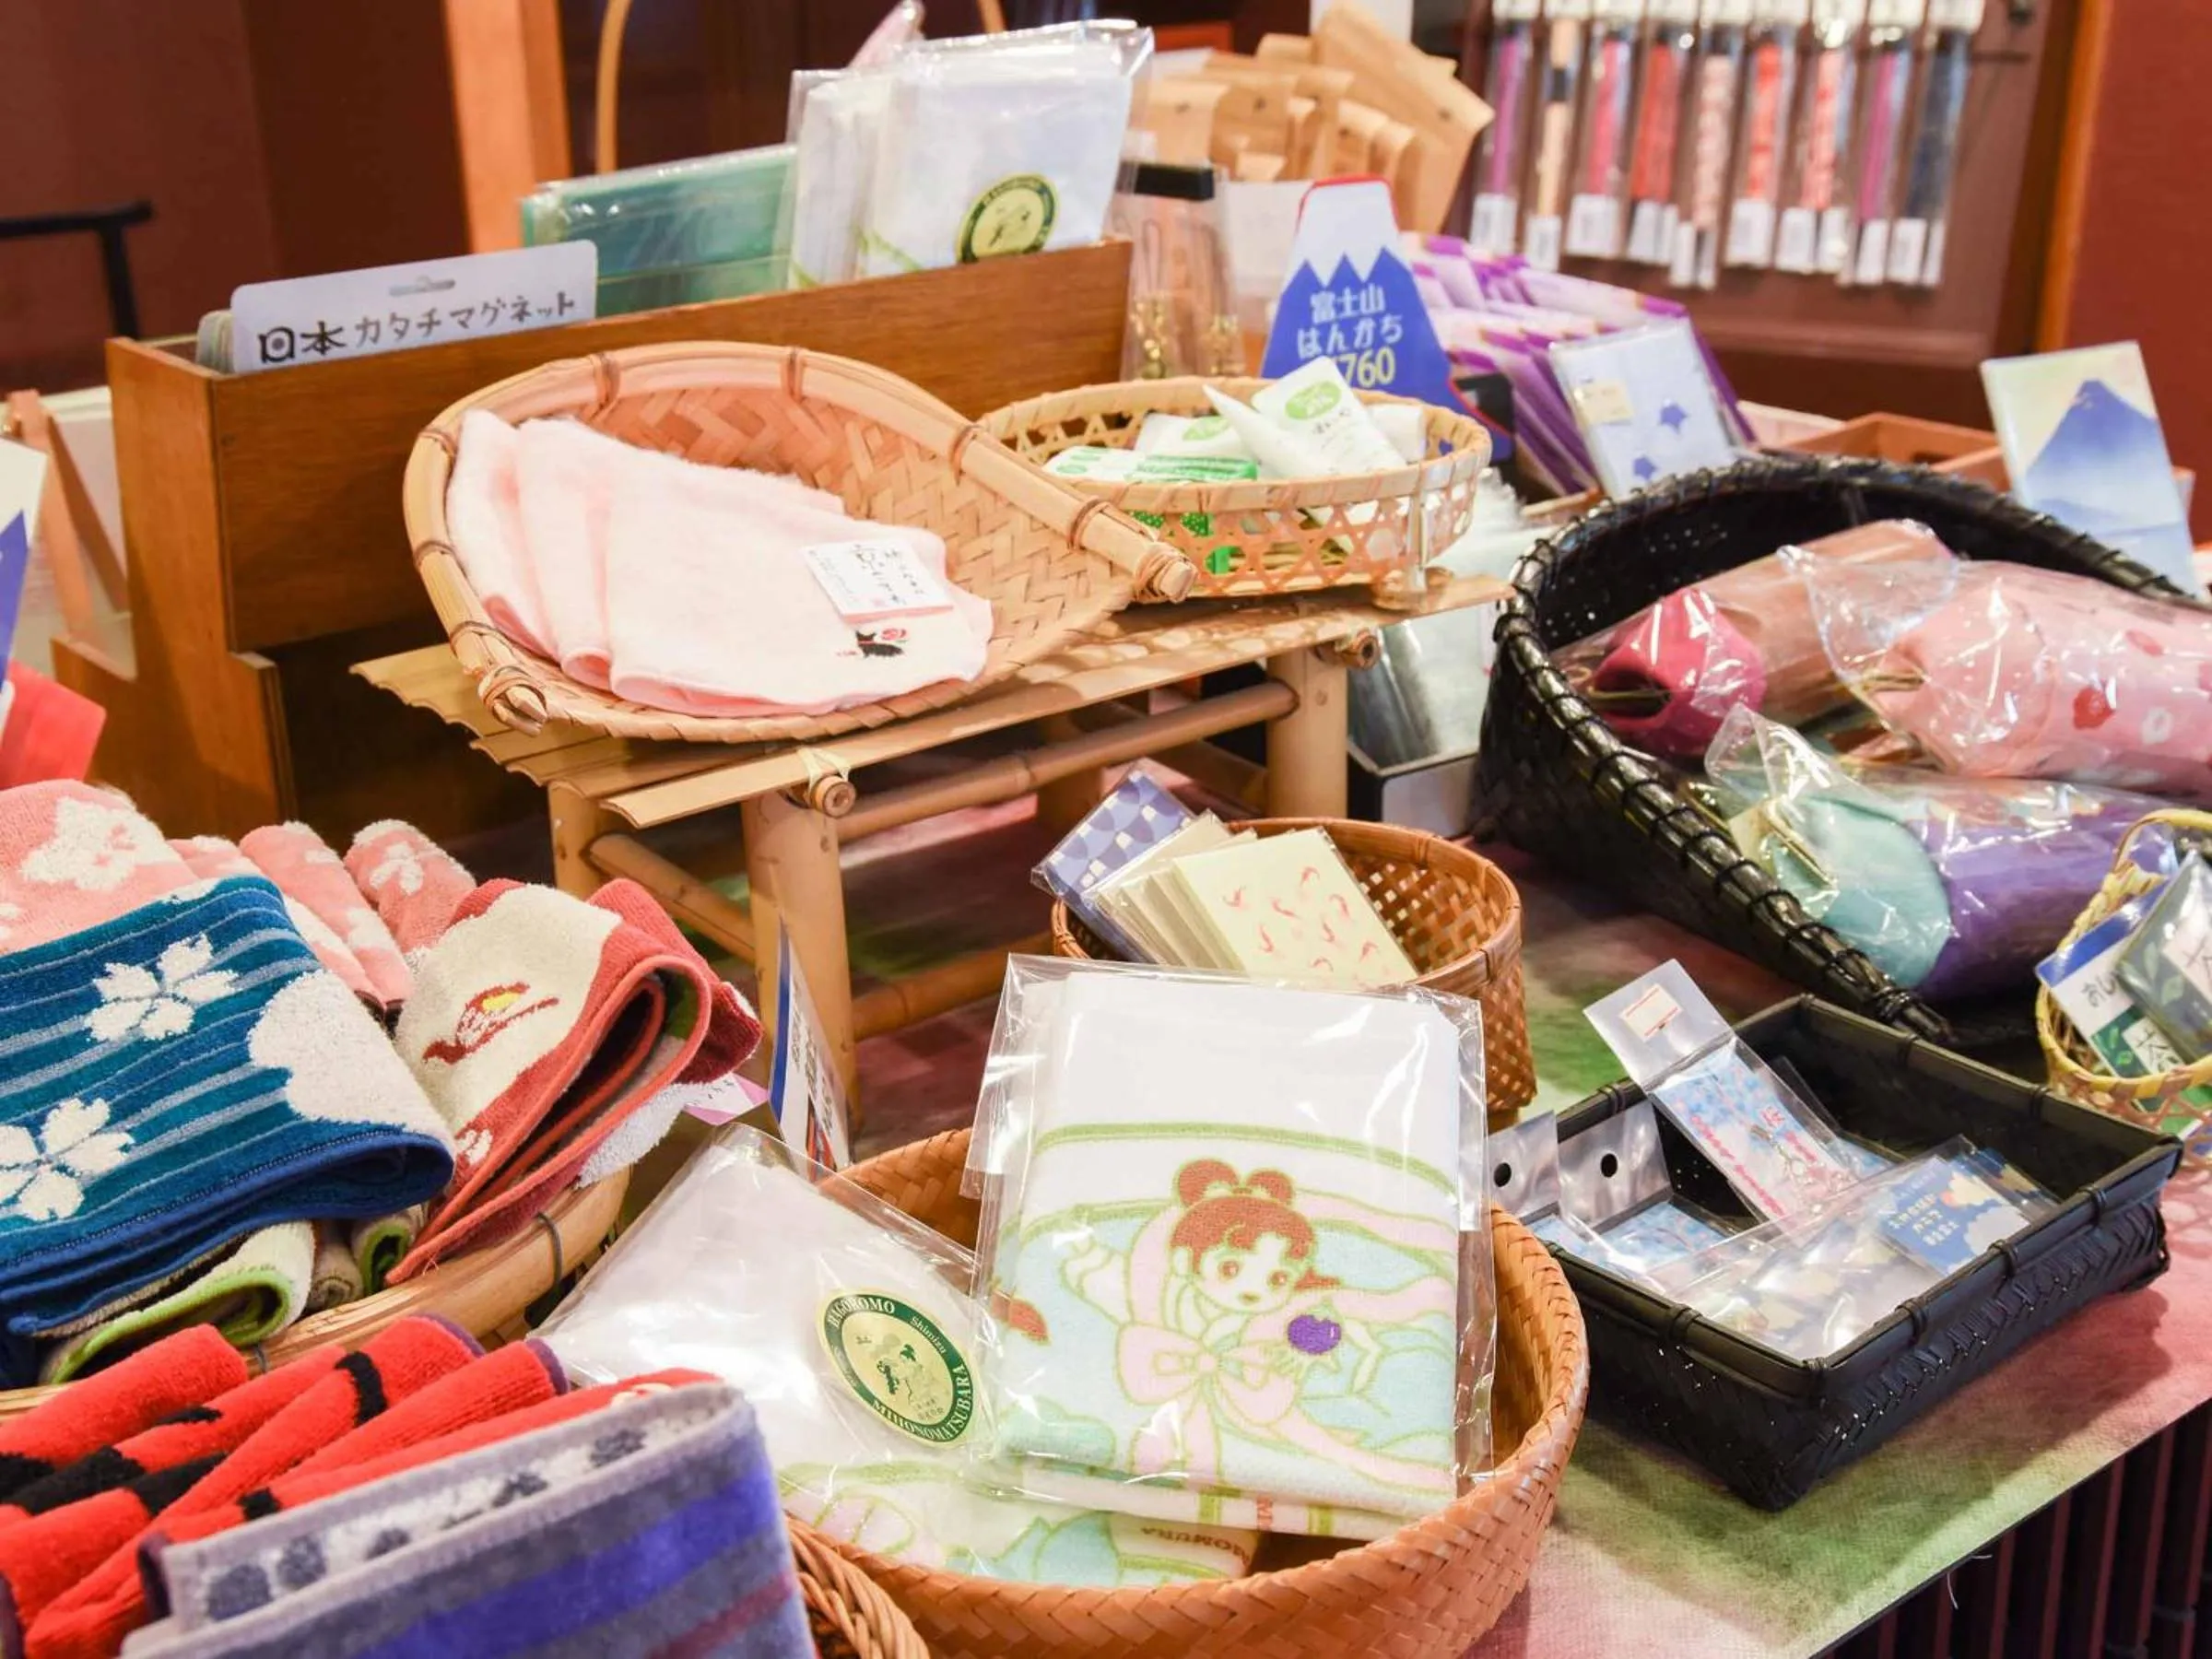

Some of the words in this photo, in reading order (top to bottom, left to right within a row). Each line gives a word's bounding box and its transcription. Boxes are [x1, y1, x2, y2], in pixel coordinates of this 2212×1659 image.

[1310, 283, 1386, 324] 富士山
[257, 290, 575, 363] 日本カタチマグネット
[1297, 314, 1404, 359] はんかち
[1331, 347, 1396, 388] 760
[827, 1297, 895, 1329] HAGOROMO
[910, 1315, 947, 1355] Shimizu
